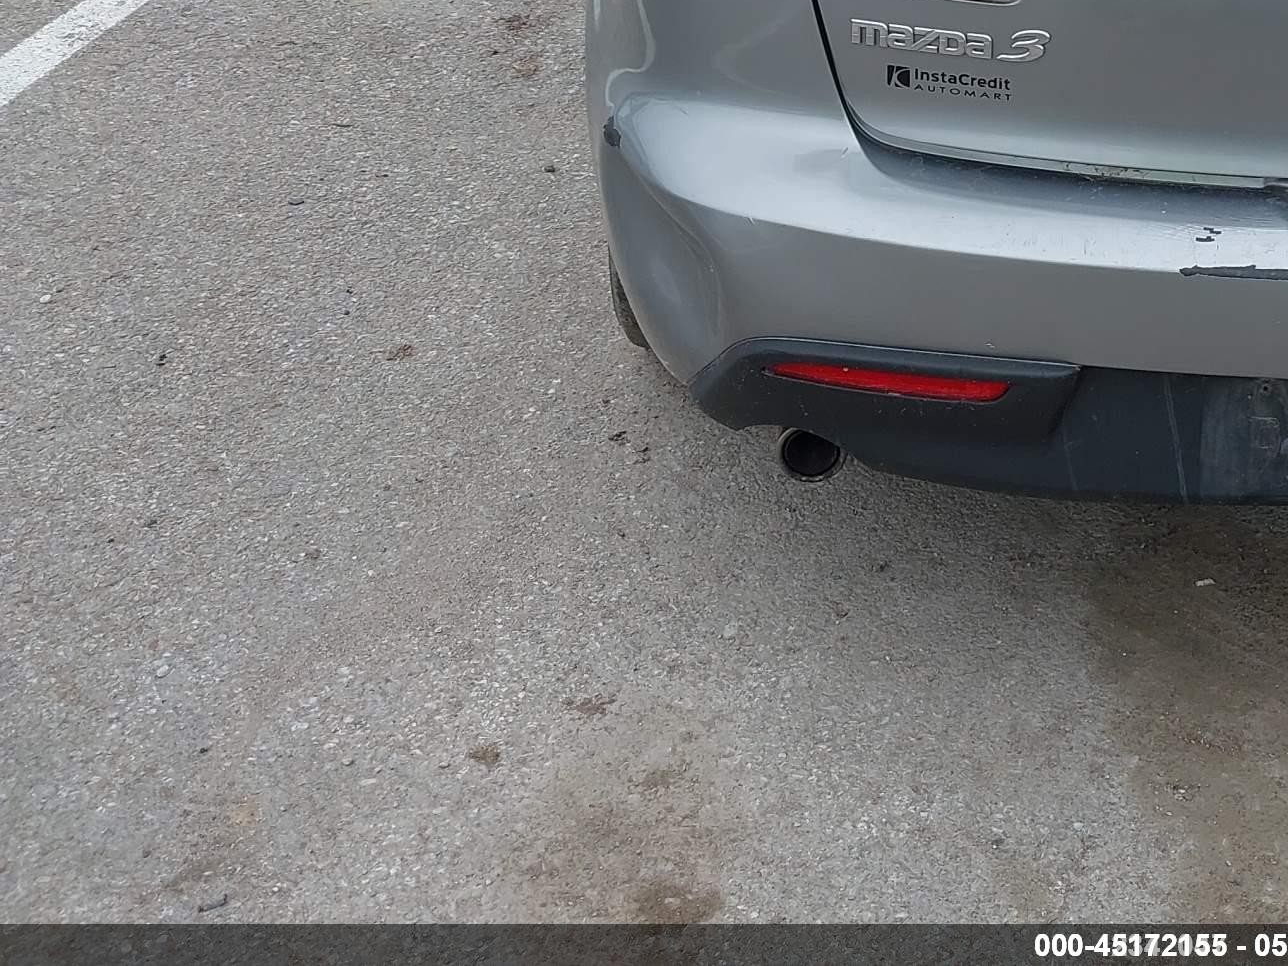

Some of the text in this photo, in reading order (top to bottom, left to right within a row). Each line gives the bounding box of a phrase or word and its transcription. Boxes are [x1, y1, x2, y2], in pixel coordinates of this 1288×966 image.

[996, 29, 1051, 63] 3
[914, 68, 1011, 91] InstaCredit
[914, 85, 1012, 101] AUTOMART
